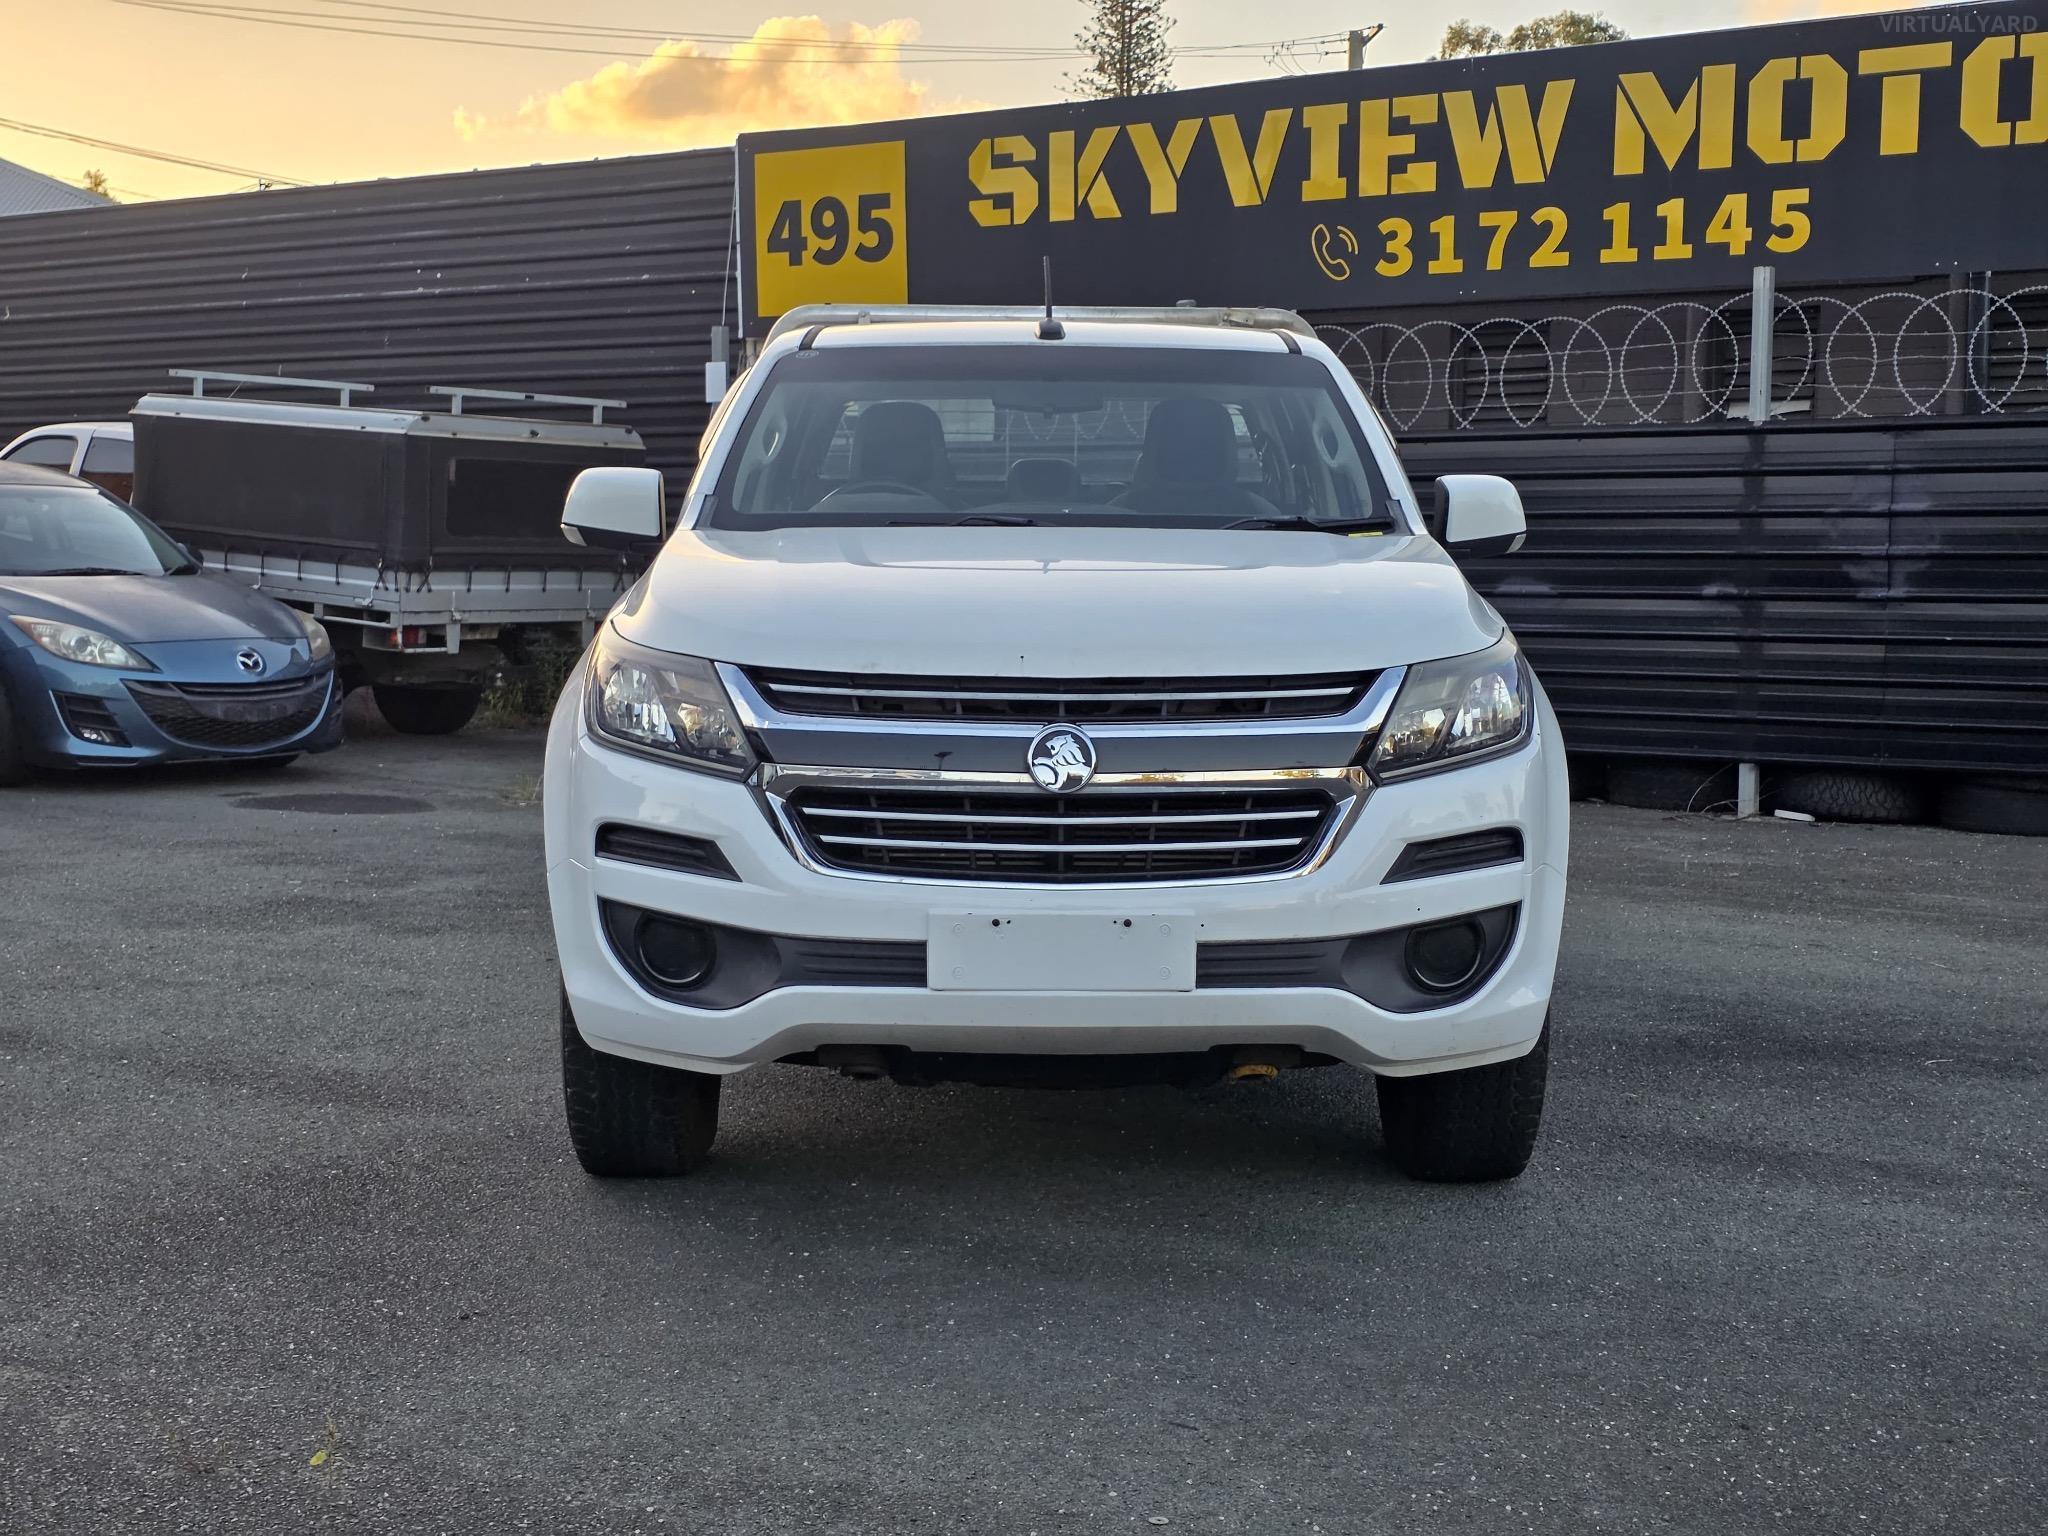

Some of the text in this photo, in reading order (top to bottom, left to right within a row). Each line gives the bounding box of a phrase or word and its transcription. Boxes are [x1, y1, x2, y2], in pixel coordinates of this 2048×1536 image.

[968, 79, 1575, 227] SKYVIEW
[766, 193, 894, 267] 495
[1375, 188, 1811, 278] 3172 1145
